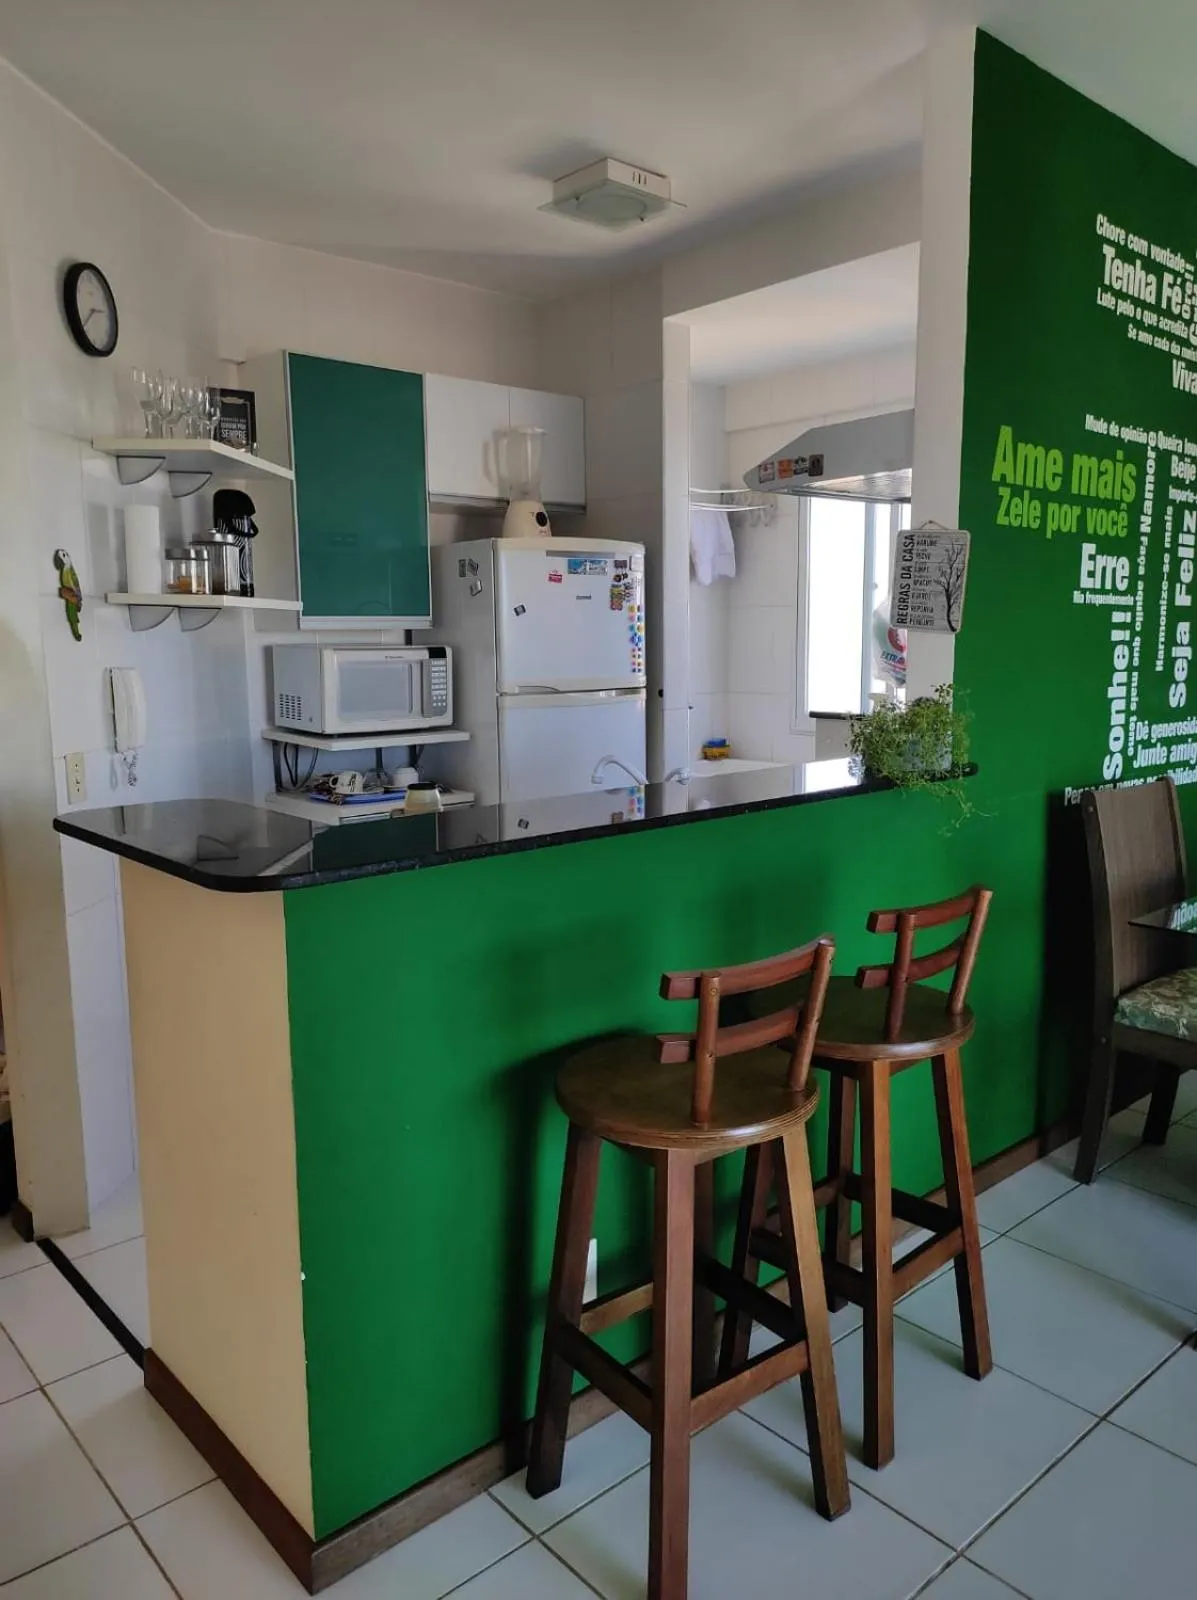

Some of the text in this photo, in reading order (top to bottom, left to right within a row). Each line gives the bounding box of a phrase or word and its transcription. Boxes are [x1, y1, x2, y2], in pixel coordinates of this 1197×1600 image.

[1096, 213, 1186, 273] Chore com vontade
[1102, 243, 1157, 304] Tenha
[1117, 299, 1135, 316] pelo
[1136, 307, 1142, 320] o
[1143, 310, 1158, 327] que
[1127, 323, 1137, 340] Se
[1109, 421, 1119, 437] de
[991, 425, 1137, 503] Ame mais
[996, 486, 1128, 539] Zele por você
[1164, 505, 1173, 549] mais
[896, 534, 916, 625] REGRAS DA CASA
[1080, 542, 1130, 591] Erre
[1169, 509, 1197, 708] Seja Feliz
[1132, 635, 1141, 667] que
[1130, 671, 1140, 711] mais
[1133, 737, 1197, 768] Junte amig
